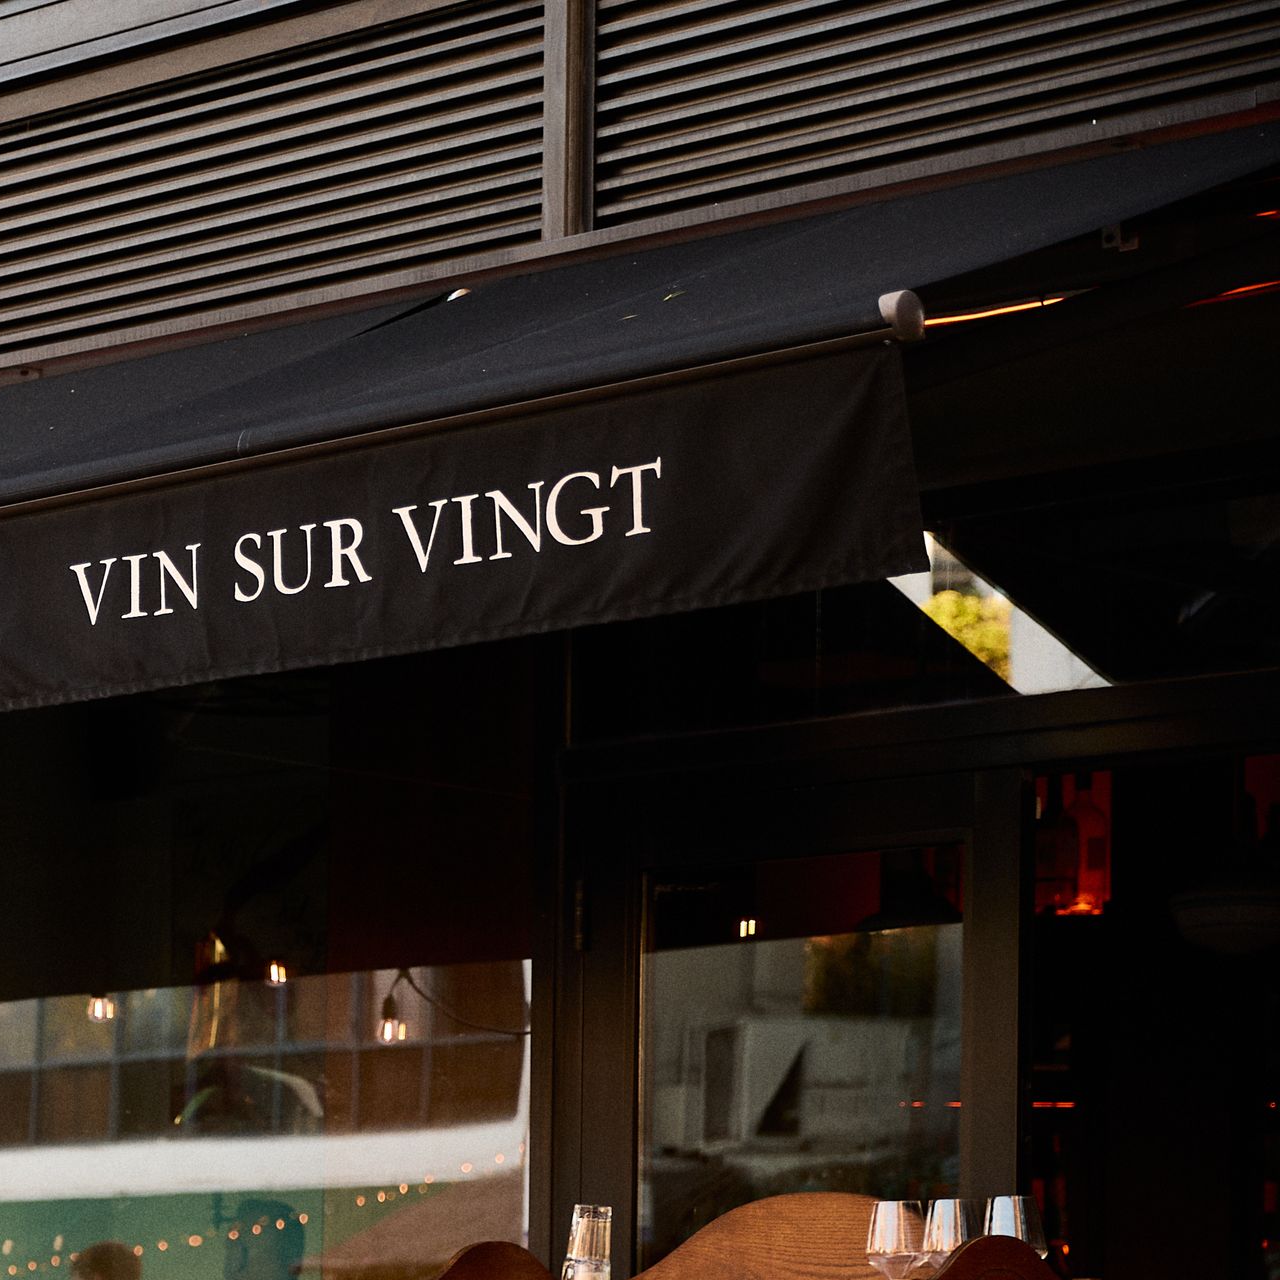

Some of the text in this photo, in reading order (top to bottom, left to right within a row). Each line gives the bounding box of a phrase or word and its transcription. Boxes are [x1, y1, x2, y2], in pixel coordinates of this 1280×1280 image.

[69, 456, 662, 626] VIN SUR VINGT
